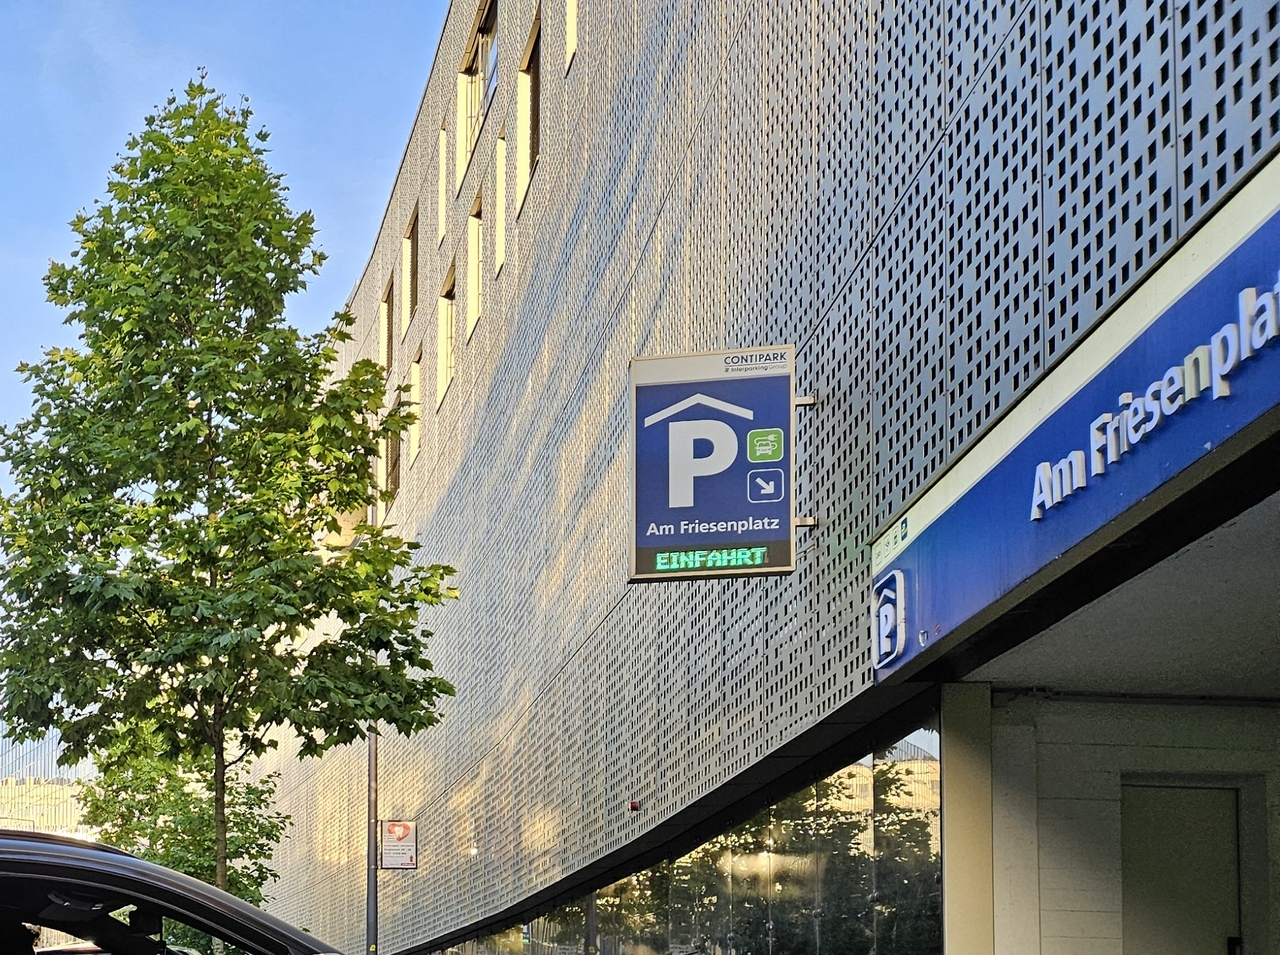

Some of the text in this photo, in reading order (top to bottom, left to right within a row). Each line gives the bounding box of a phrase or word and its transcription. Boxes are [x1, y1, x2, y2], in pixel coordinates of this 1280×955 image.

[724, 352, 787, 365] CONTIPARK
[669, 420, 738, 508] P
[1030, 450, 1086, 521] Am
[646, 516, 780, 536] Am Friesenplatz
[656, 547, 768, 570] EINFAHRT
[879, 603, 896, 656] P
